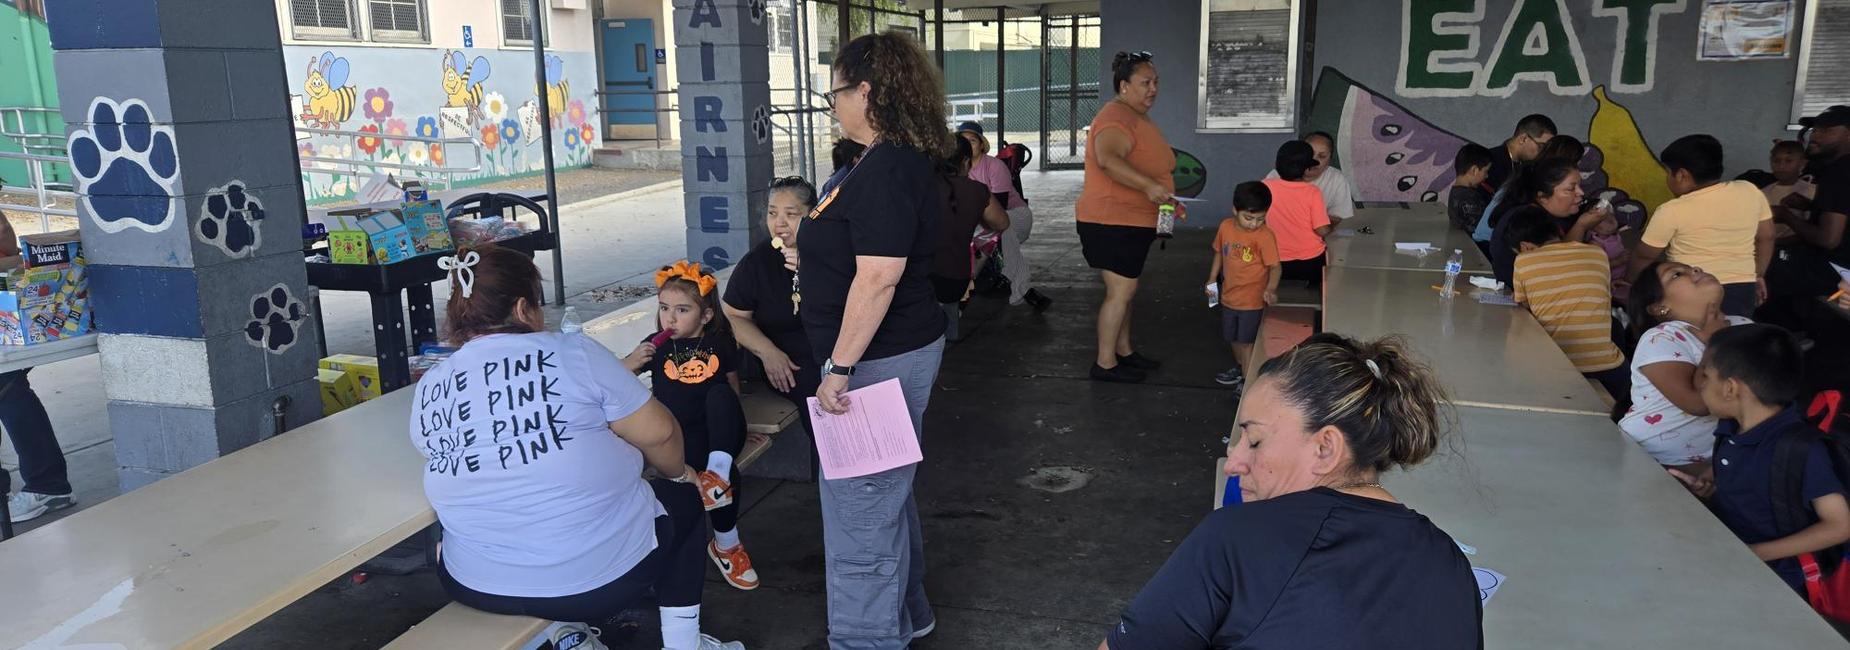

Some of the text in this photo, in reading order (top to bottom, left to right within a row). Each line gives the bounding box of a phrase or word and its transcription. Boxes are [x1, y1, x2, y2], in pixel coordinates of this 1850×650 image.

[1395, 0, 1687, 98] EAT
[31, 244, 65, 255] Minute
[37, 252, 62, 263] Maid
[28, 285, 38, 294] 24
[421, 350, 558, 410] LOVE PINK
[420, 375, 562, 437] LOVE PINK
[492, 404, 568, 443] PINK
[429, 426, 574, 477] LOVE PINK
[559, 633, 580, 650] NIKE
